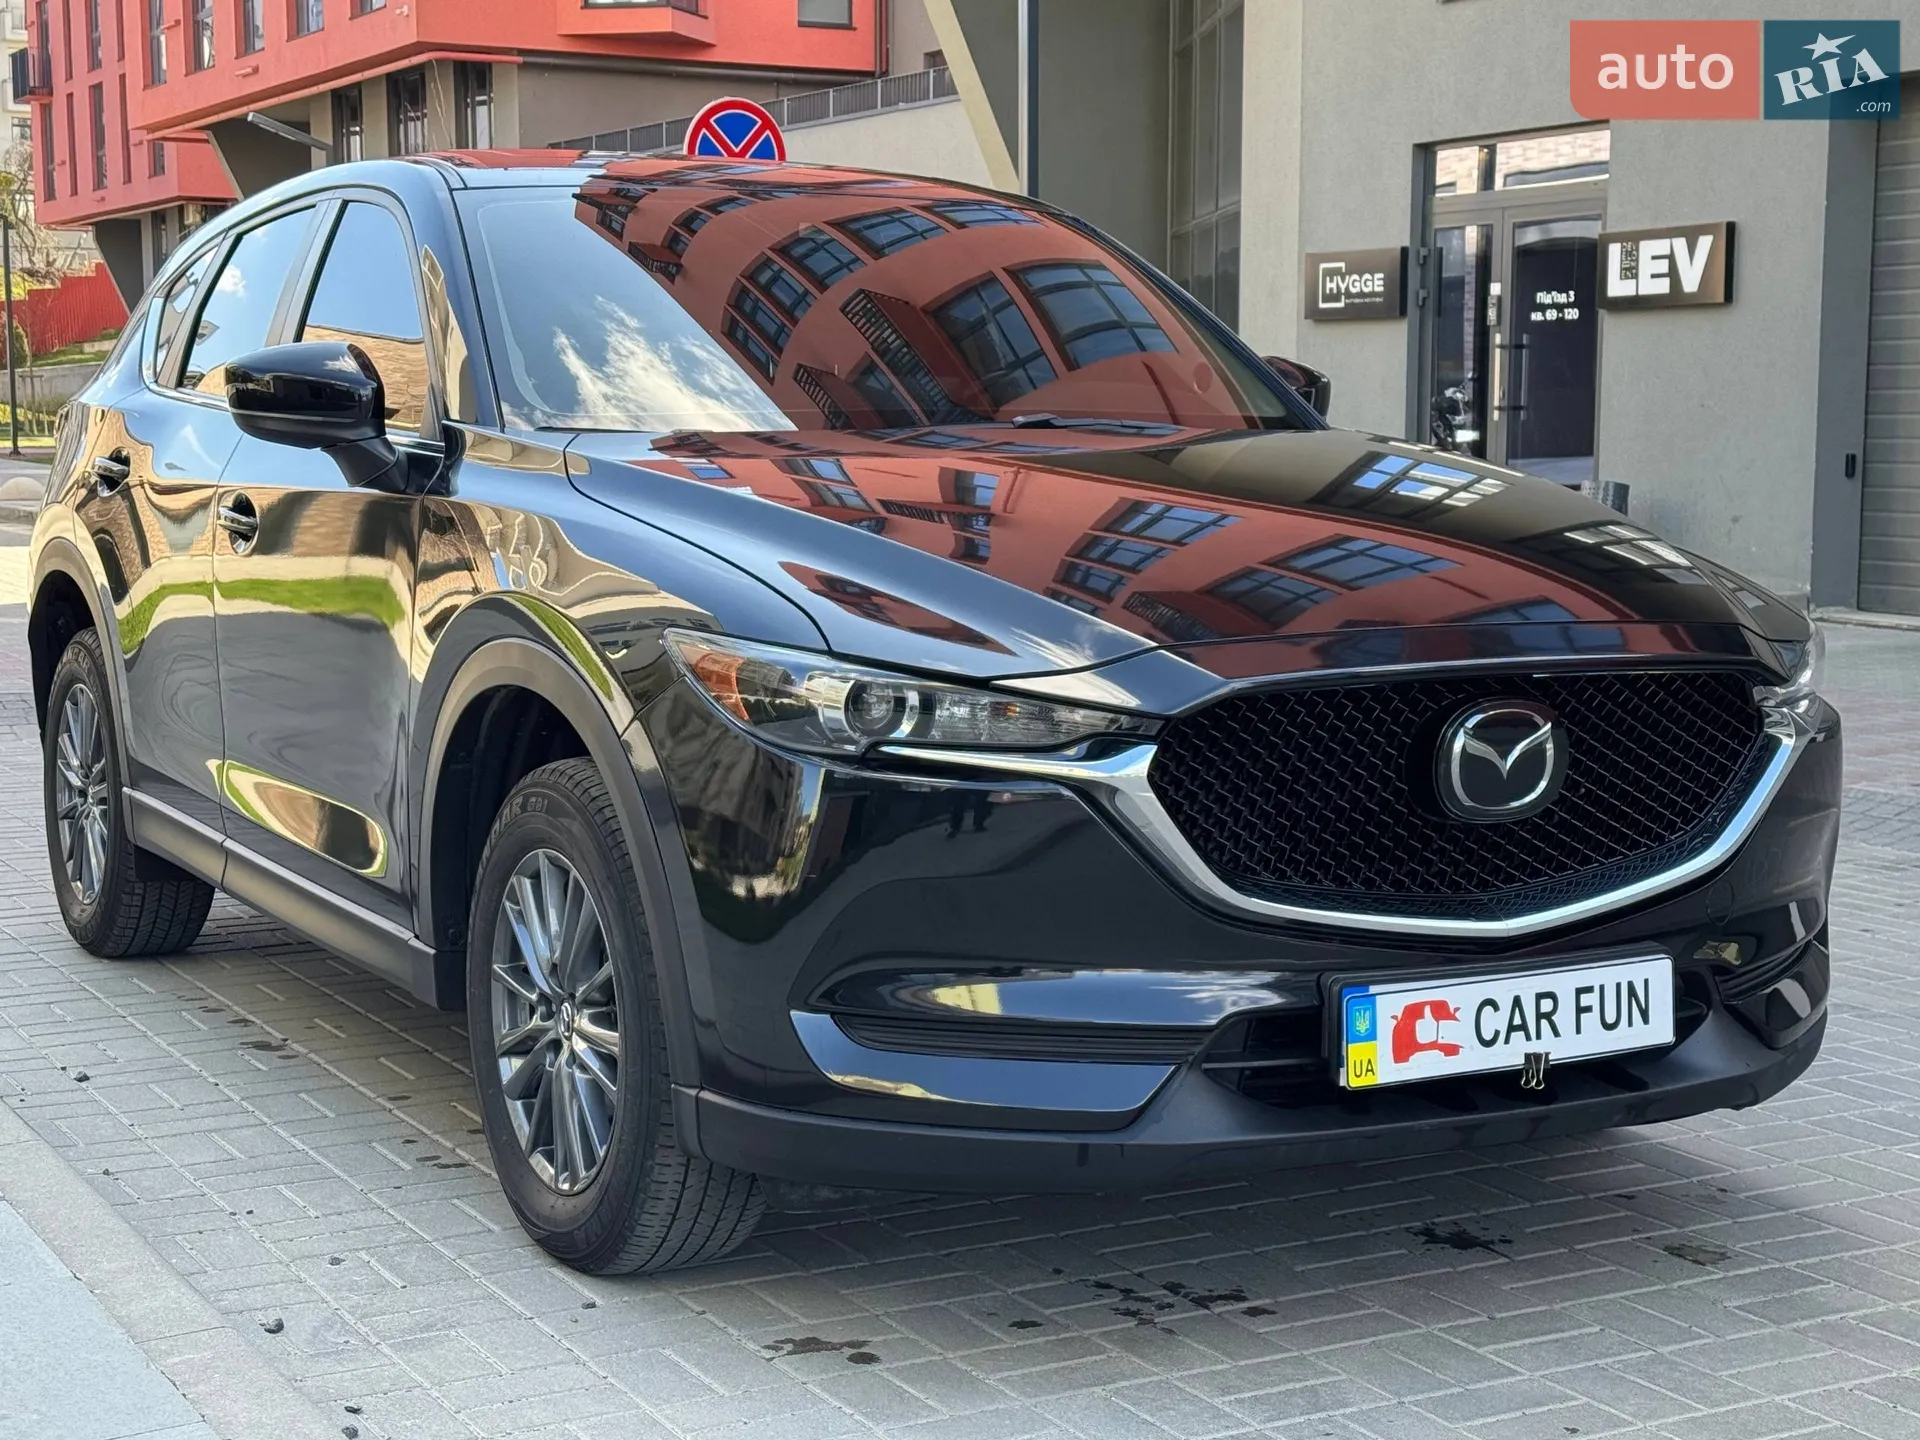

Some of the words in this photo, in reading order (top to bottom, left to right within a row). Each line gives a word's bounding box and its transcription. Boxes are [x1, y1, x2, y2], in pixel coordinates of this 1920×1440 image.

[1607, 235, 1714, 297] LEV
[1326, 272, 1384, 294] HYGGE
[1568, 290, 1575, 302] 3
[1546, 308, 1557, 320] 69
[1564, 308, 1579, 320] 120
[1475, 991, 1562, 1049] CAR
[1575, 978, 1651, 1035] FUN
[1353, 1058, 1376, 1078] UA
